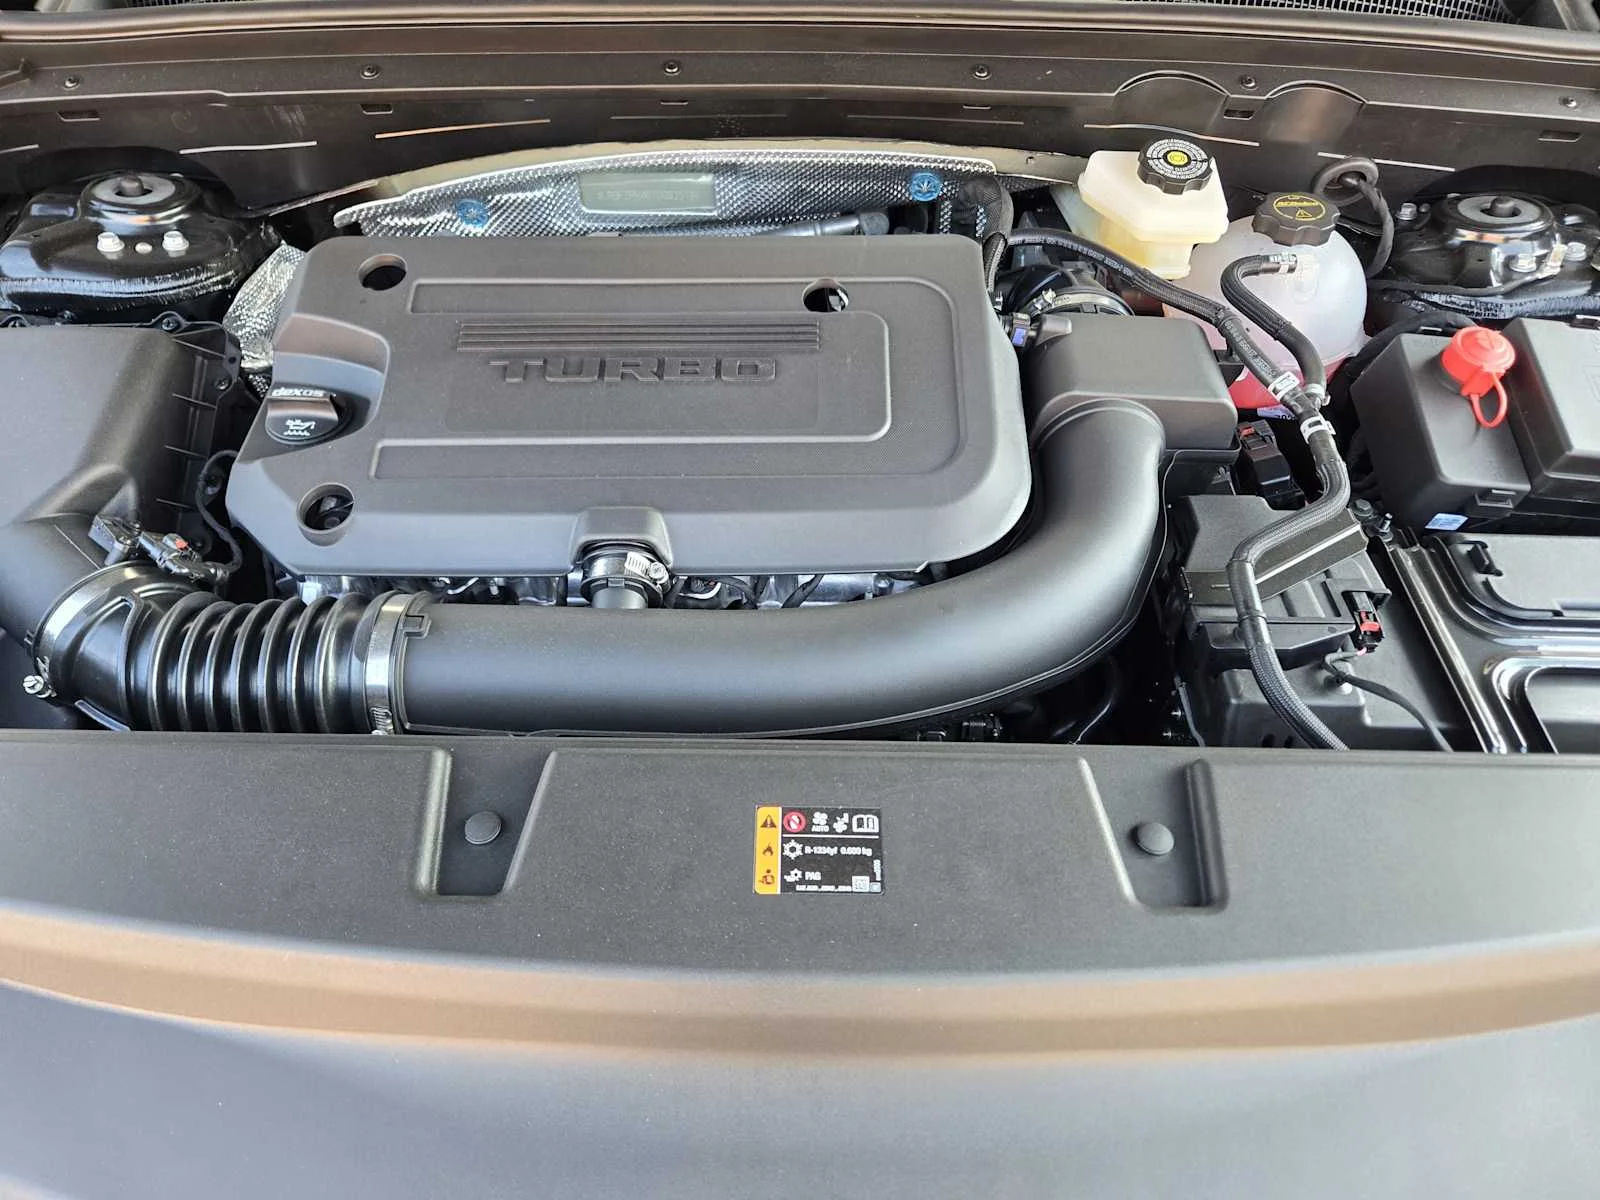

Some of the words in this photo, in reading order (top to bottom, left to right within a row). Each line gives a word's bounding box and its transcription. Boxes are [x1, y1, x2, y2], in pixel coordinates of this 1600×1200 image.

[488, 356, 776, 383] TURBO
[271, 387, 326, 397] dexos
[804, 871, 822, 881] PAG
